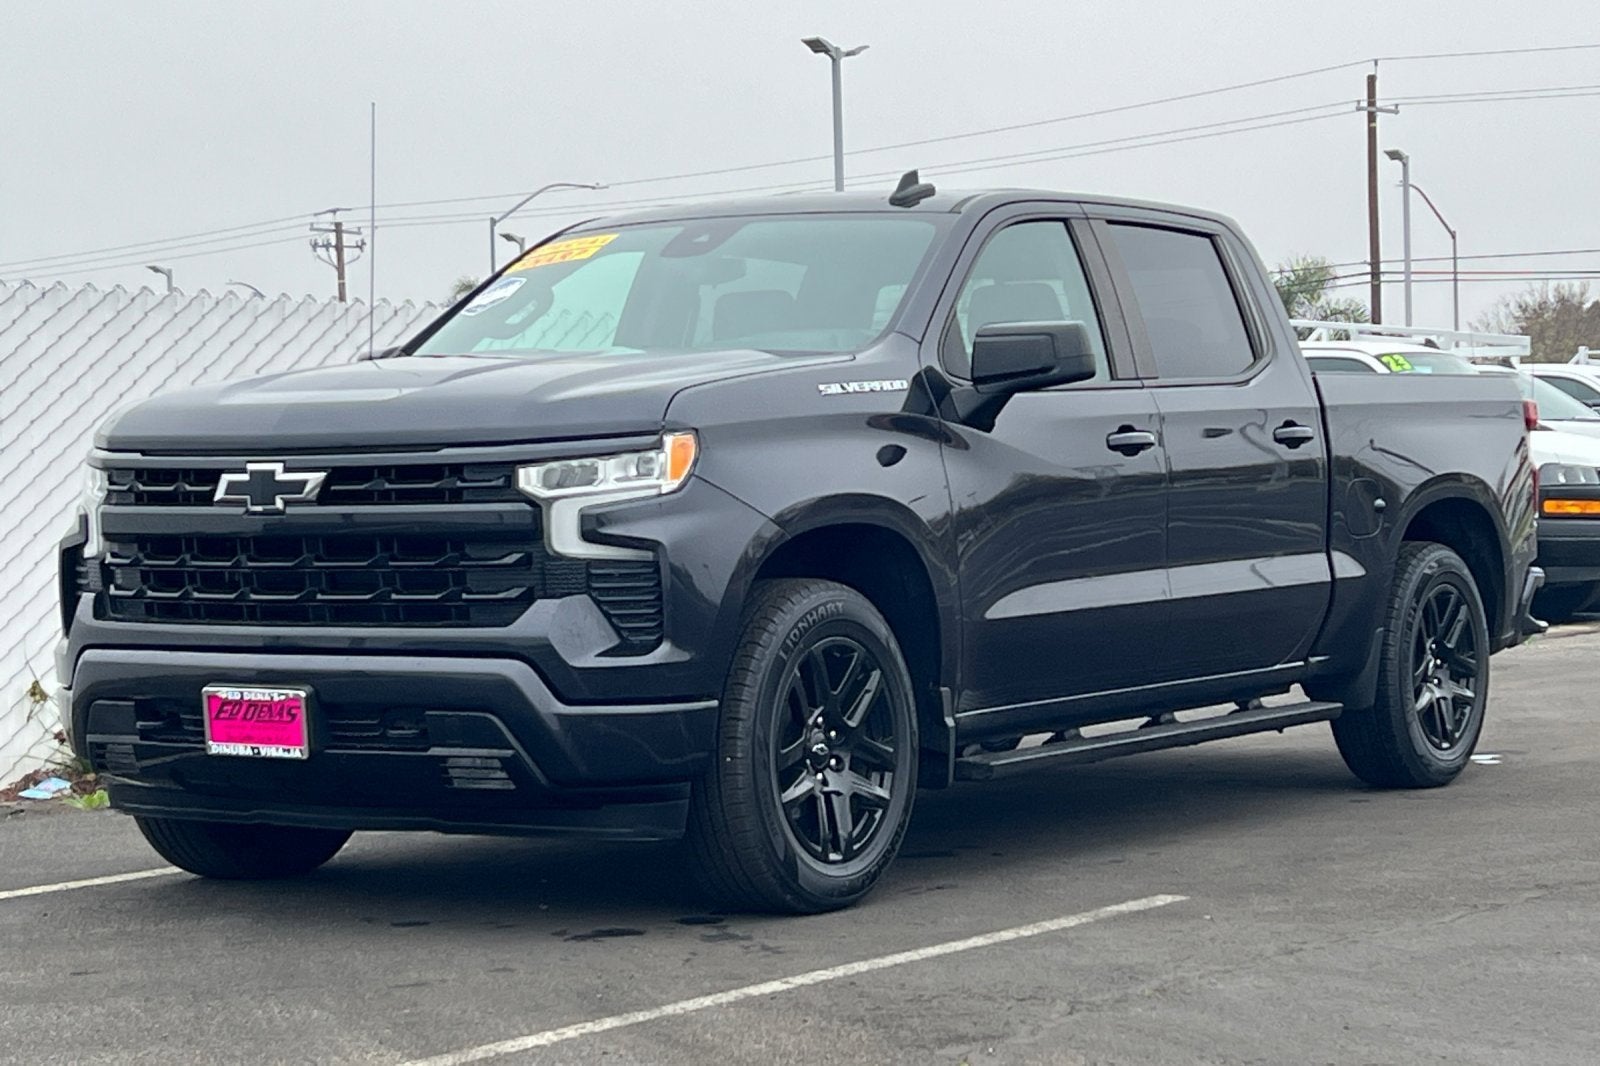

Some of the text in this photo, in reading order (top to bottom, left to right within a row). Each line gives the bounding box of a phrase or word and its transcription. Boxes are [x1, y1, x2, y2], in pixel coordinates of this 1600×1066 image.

[1381, 353, 1413, 373] 23
[818, 379, 908, 396] SILVERADO
[779, 601, 844, 661] LIONHART
[214, 701, 242, 720] ED
